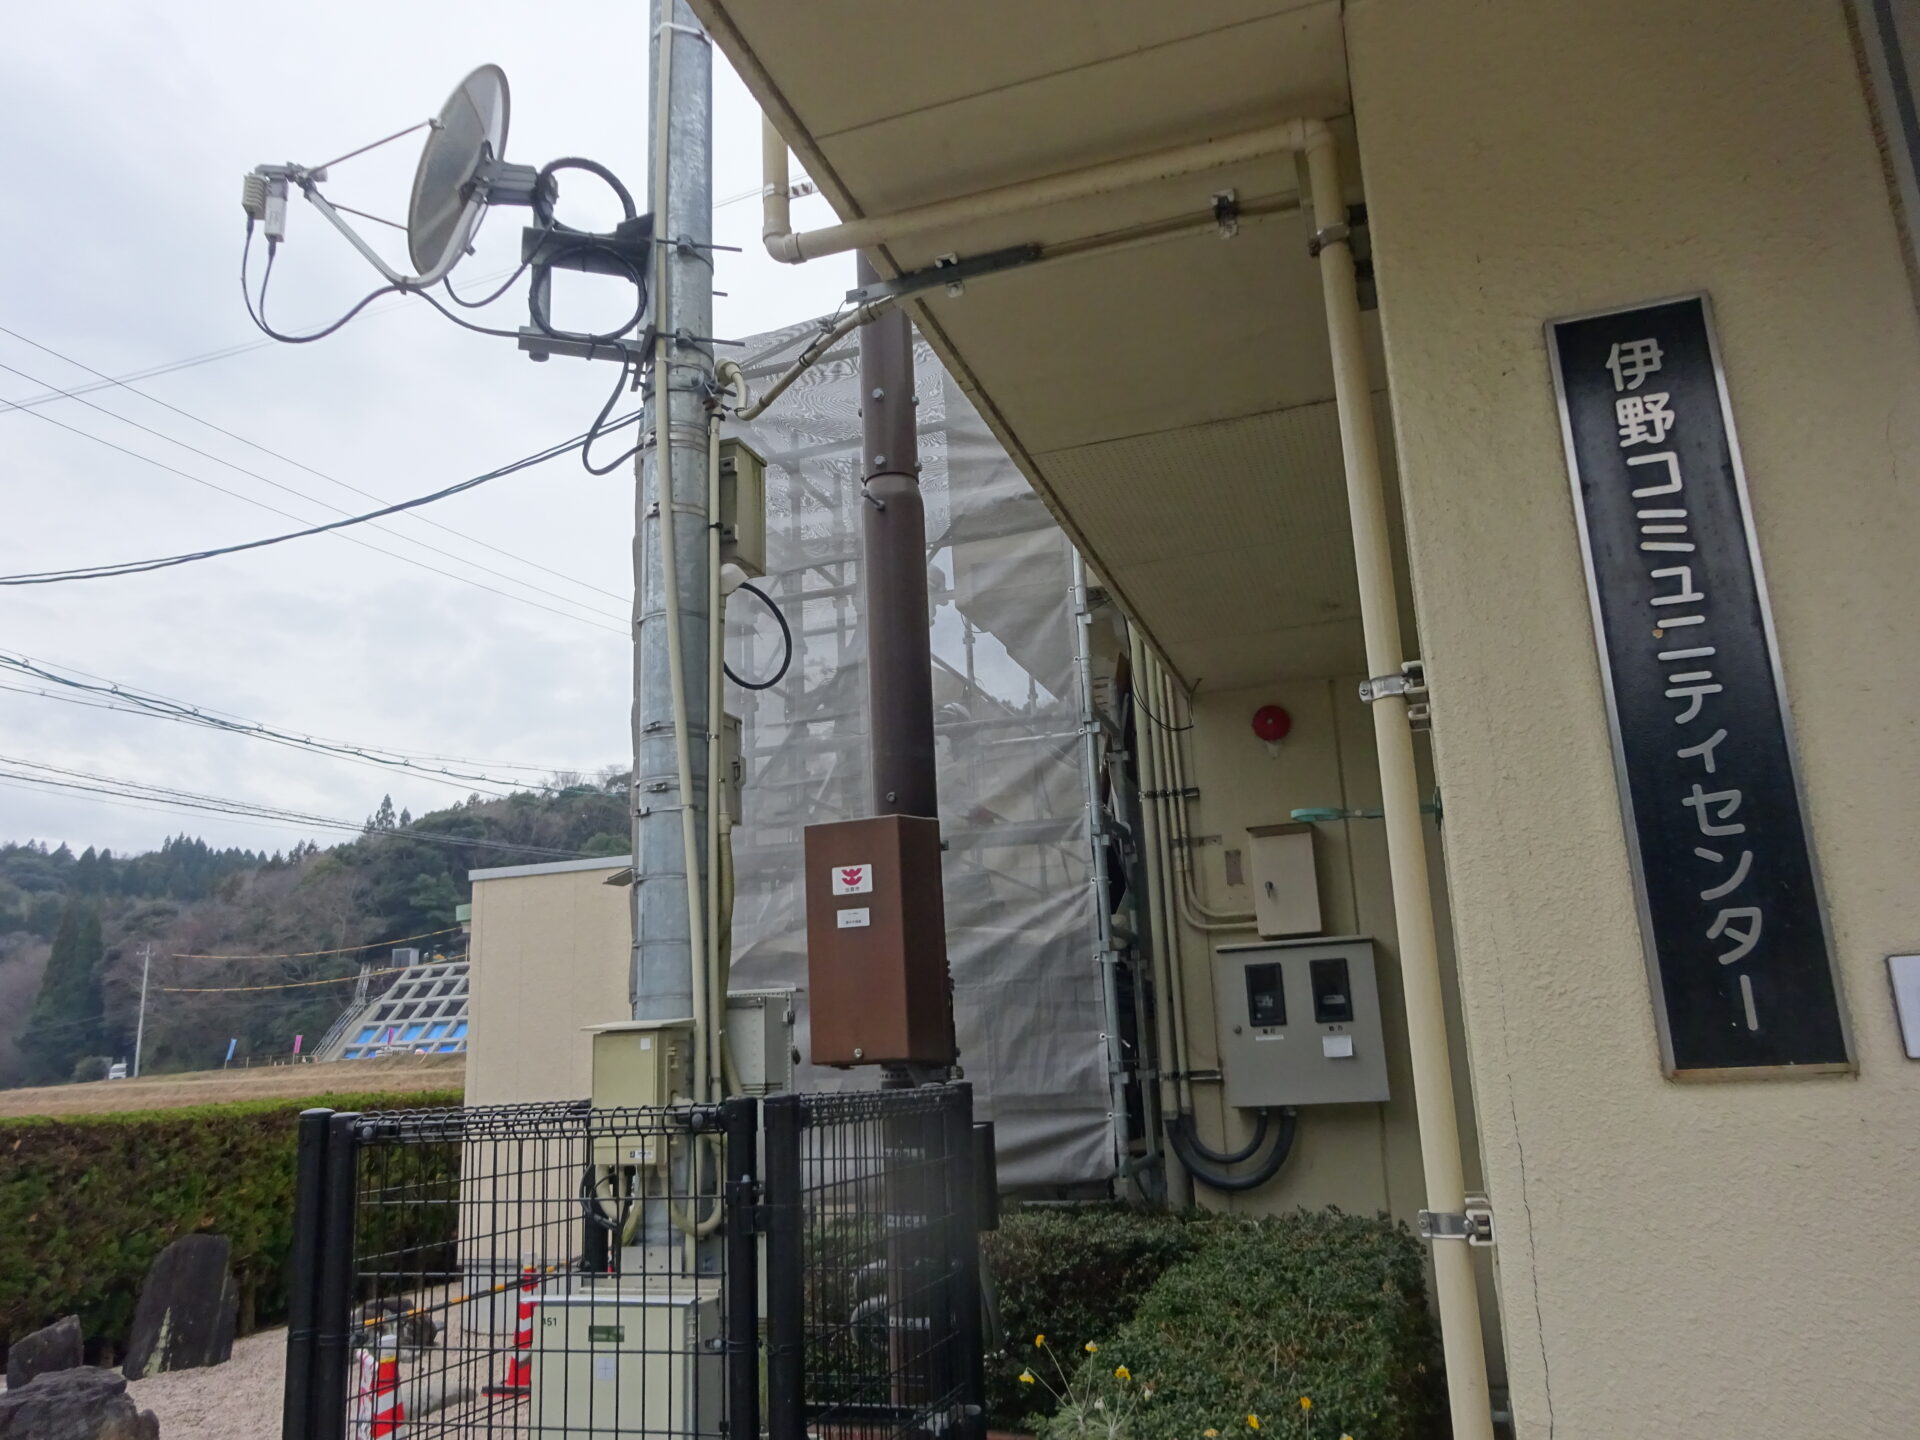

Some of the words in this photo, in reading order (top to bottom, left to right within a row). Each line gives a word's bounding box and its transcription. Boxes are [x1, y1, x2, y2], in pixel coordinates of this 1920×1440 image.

[1605, 337, 1762, 1031] 伊野コミュニティセンター
